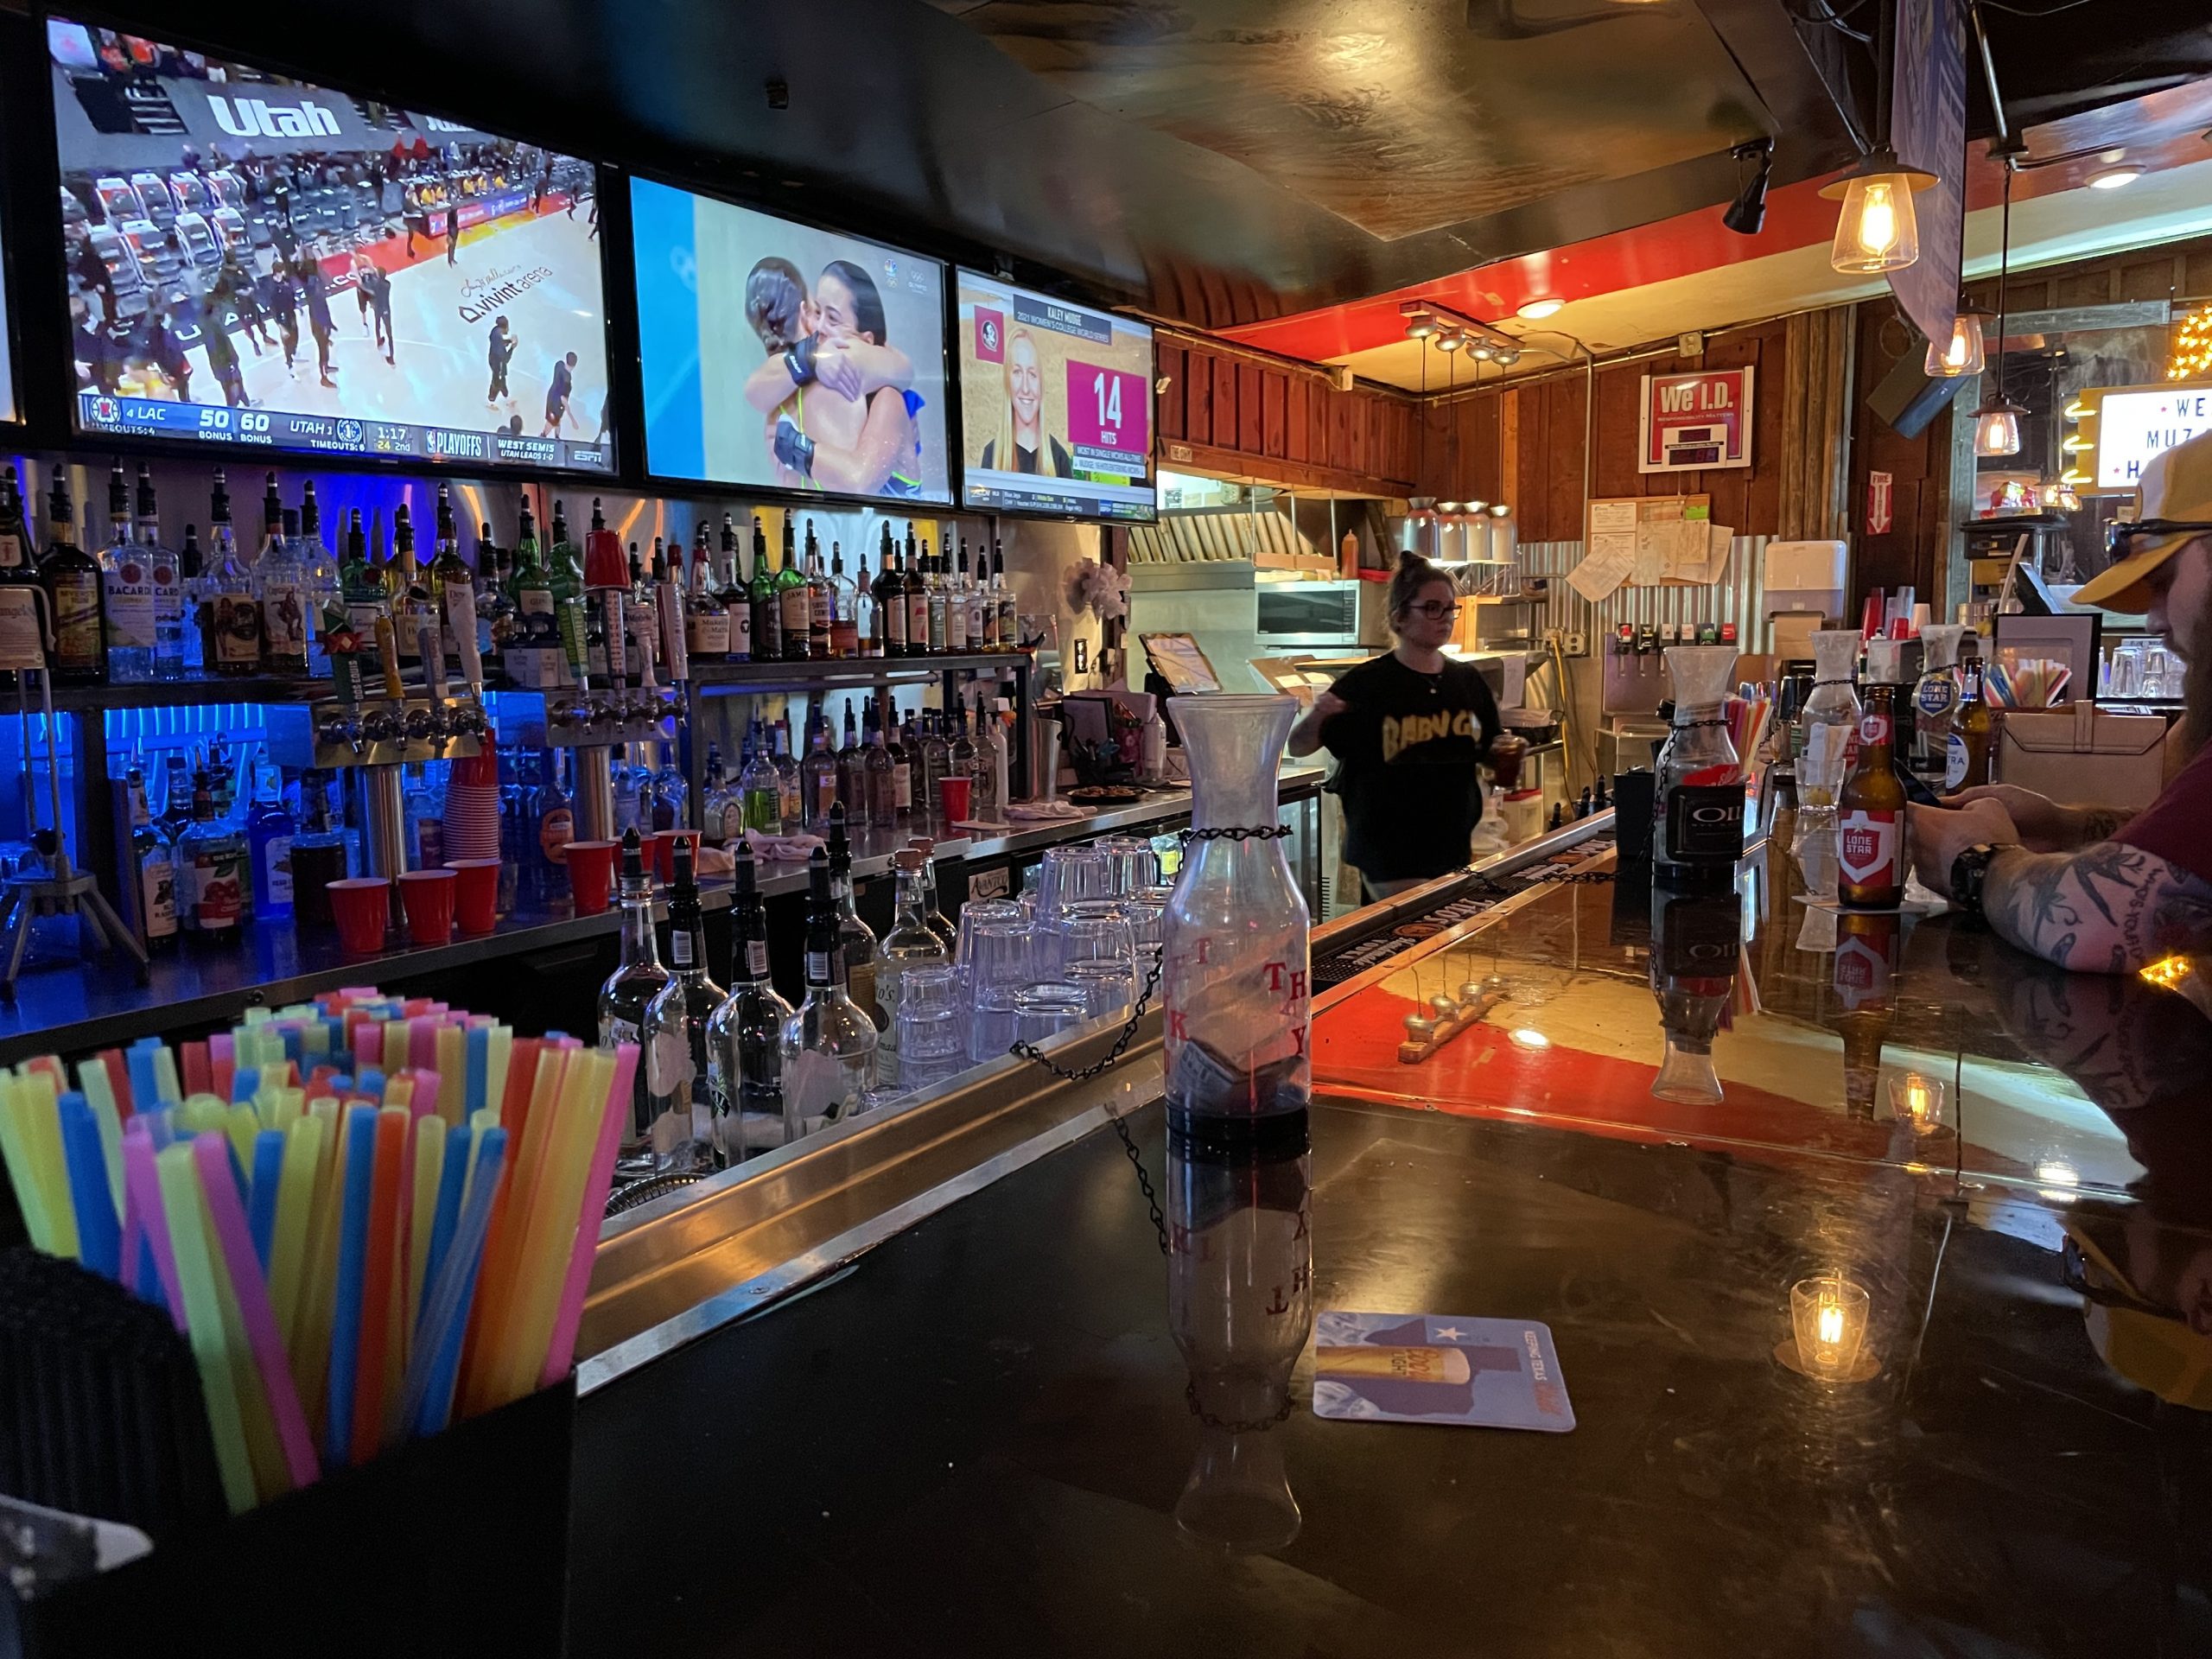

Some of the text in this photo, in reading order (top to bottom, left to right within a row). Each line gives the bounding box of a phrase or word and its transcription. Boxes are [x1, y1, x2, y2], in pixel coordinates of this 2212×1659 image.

[207, 95, 342, 137] Utah
[516, 266, 554, 289] arena
[1094, 372, 1122, 429] 14
[1660, 381, 1734, 414] We I.D.
[137, 406, 166, 422] LAC
[199, 408, 230, 429] 50
[239, 412, 270, 432] 60
[289, 420, 325, 435] UTAH
[198, 430, 233, 442] BONUS
[239, 433, 273, 445] BONUS
[378, 427, 407, 441] 1:17
[1101, 430, 1117, 446] HITS
[377, 441, 411, 453] 24 2nd
[436, 432, 482, 457] PLAYOFFS
[497, 439, 556, 454] WEST SEMIS
[500, 449, 520, 460] UTAH
[574, 450, 602, 463] ESPN
[1872, 474, 1890, 484] FIRE
[1923, 685, 1949, 694] LONE
[1921, 693, 1948, 702] STAR
[1846, 835, 1873, 846] LONE
[1846, 844, 1873, 855] STAR
[1336, 938, 1389, 961] VODKA
[1530, 1358, 1548, 1382] TEXAS
